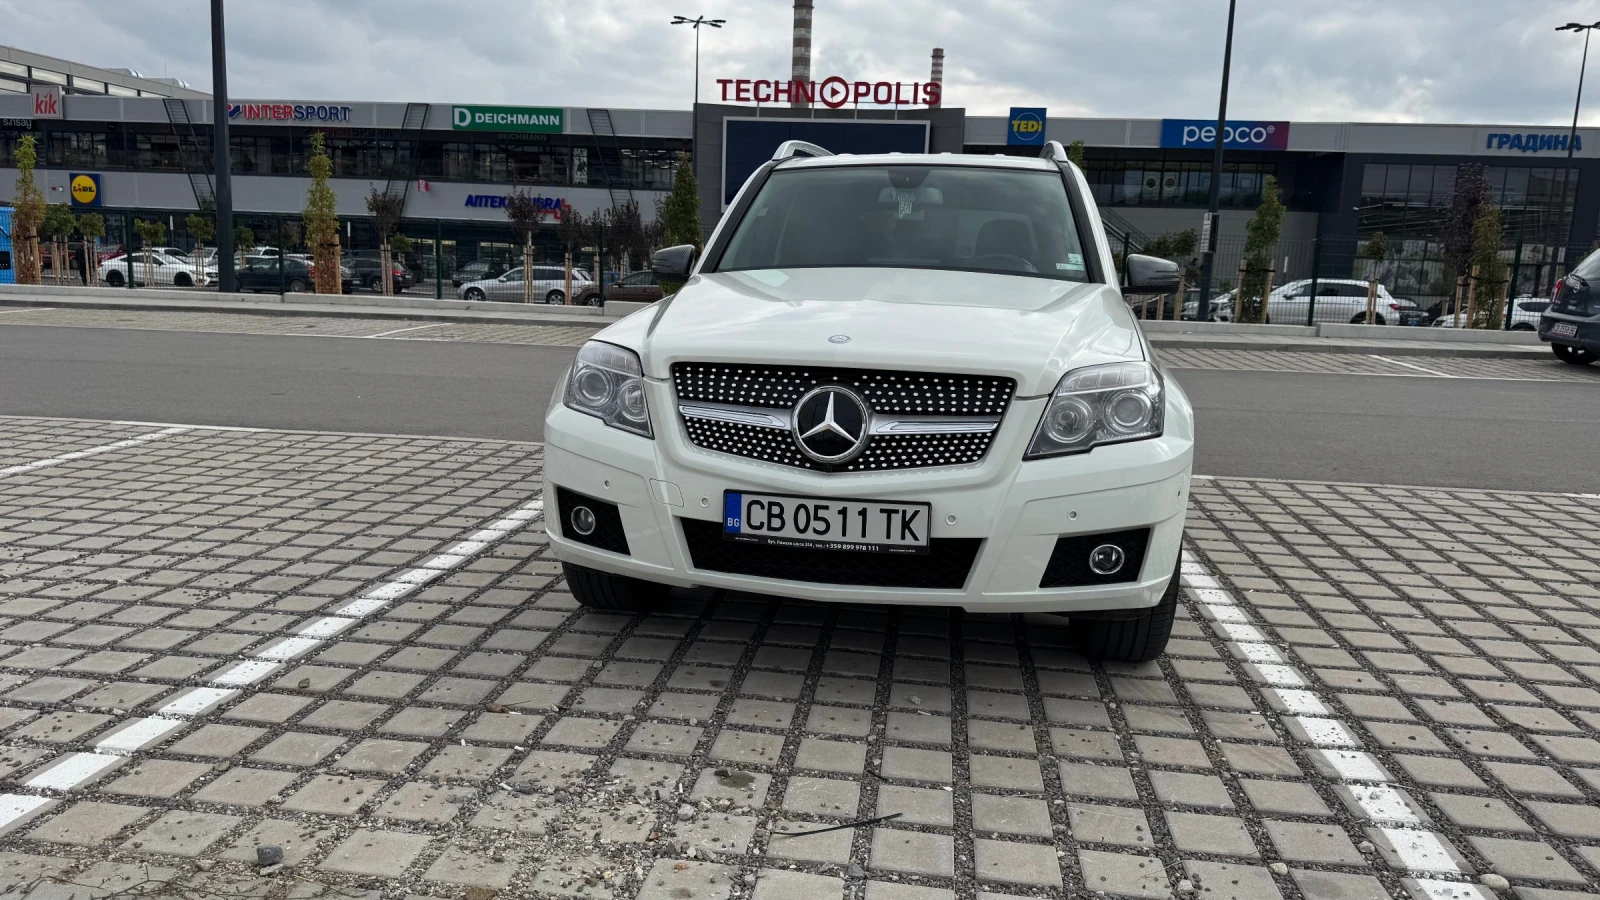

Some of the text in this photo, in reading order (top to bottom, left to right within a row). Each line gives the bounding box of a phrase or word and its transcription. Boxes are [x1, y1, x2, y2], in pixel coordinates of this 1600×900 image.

[716, 76, 941, 109] TECHNOPOLIS
[243, 103, 352, 121] INTERSPORT
[475, 113, 560, 126] DEICHMANN
[497, 132, 547, 141] DEICHMANN
[1486, 133, 1582, 153] ГРАДИНА
[464, 194, 516, 209] АПТЕК
[727, 517, 740, 527] BG
[746, 499, 921, 541] CB 0511 TK
